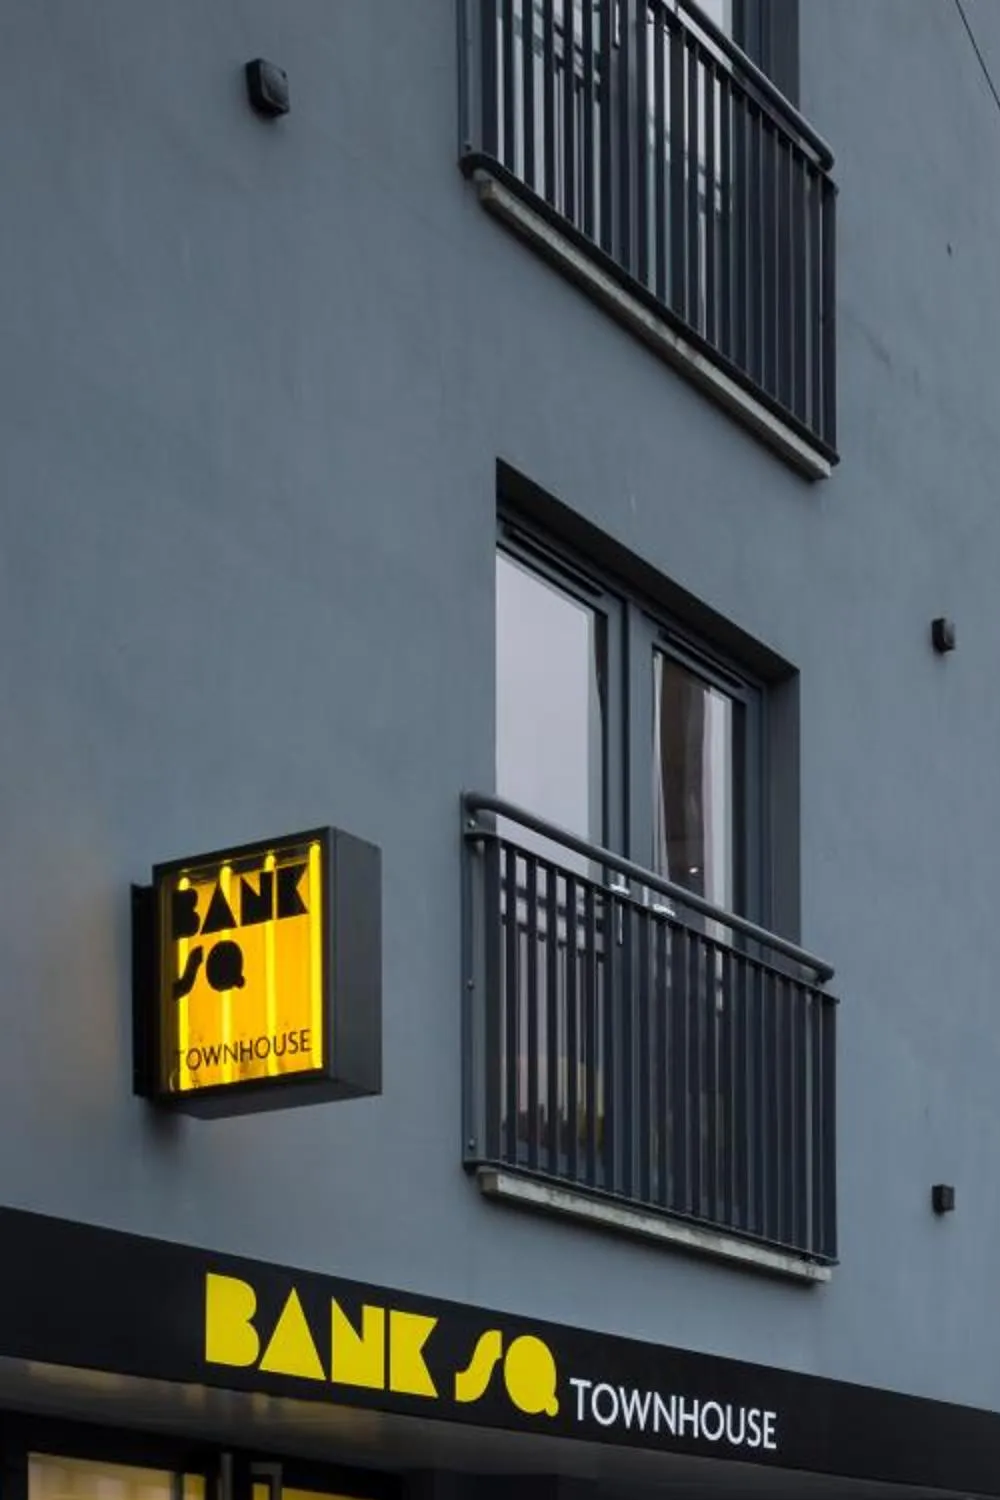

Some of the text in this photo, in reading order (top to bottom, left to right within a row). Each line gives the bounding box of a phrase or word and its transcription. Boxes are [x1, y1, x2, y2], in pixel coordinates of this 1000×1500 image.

[171, 863, 309, 940] BANK
[172, 940, 245, 1000] SQ
[205, 1272, 777, 1450] BANK SQ TOWNHOUSE
